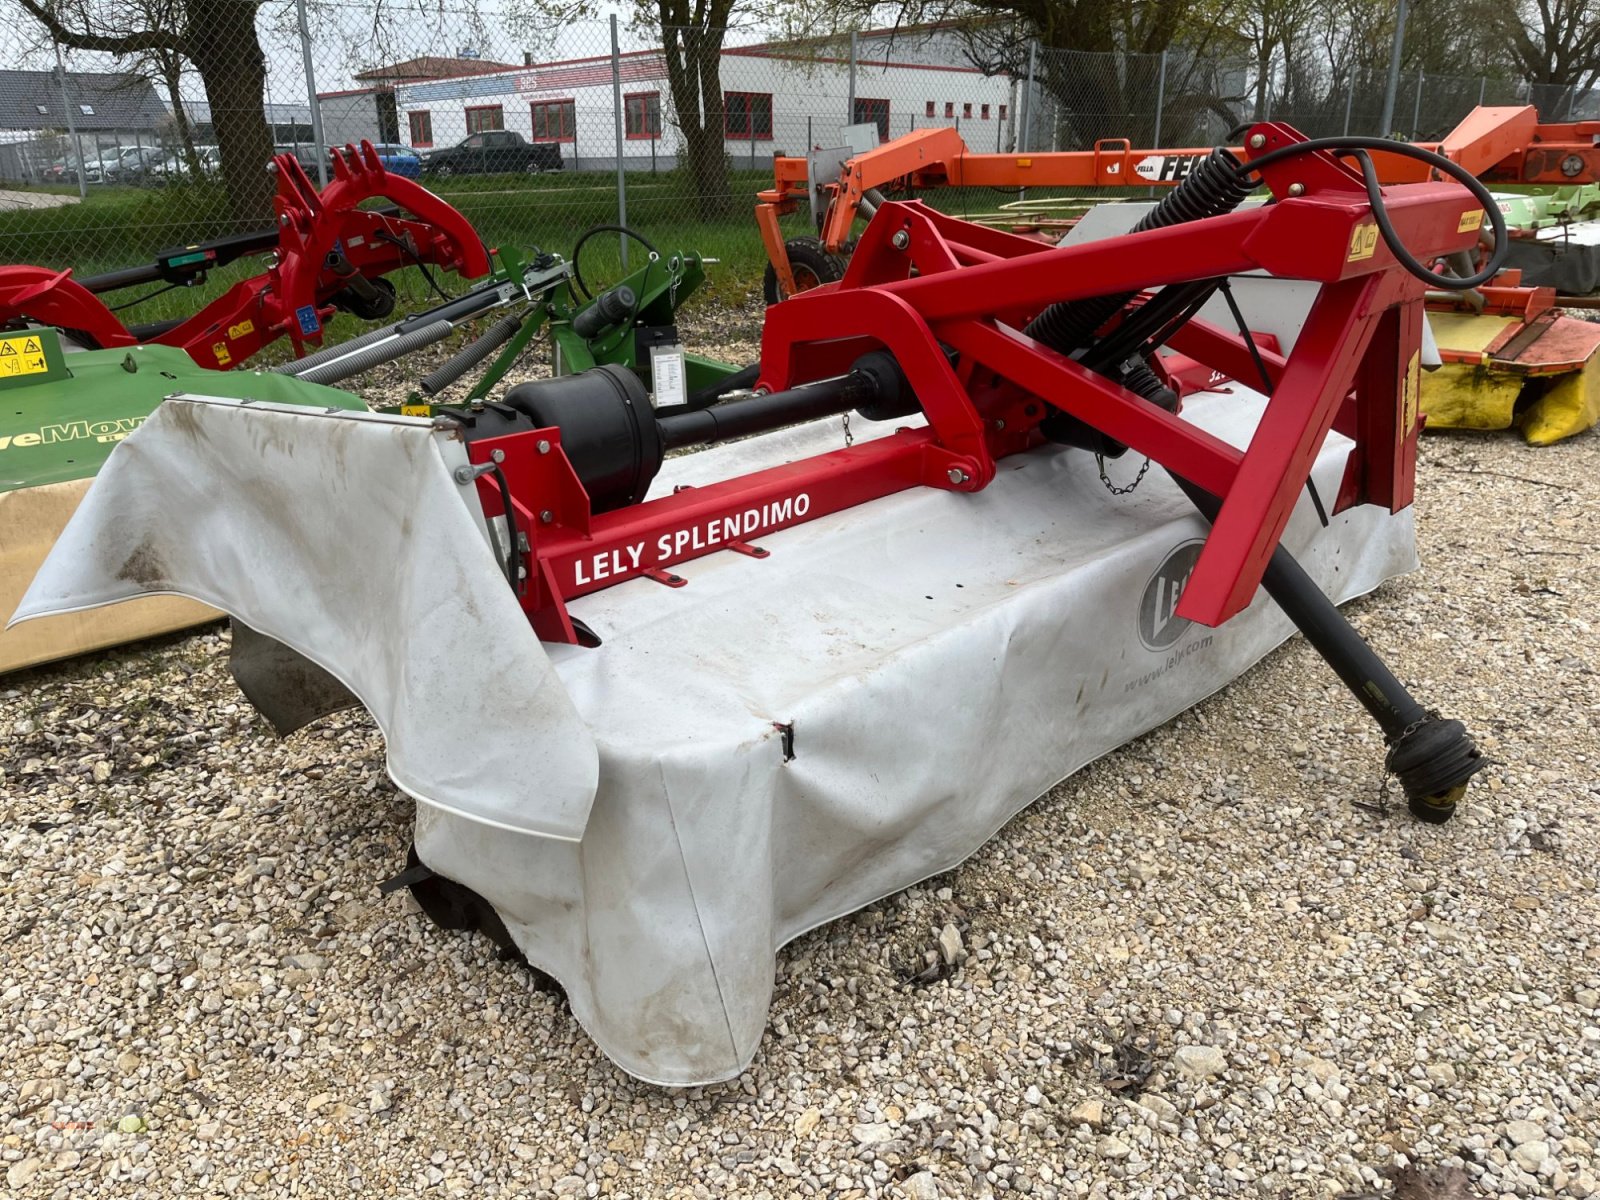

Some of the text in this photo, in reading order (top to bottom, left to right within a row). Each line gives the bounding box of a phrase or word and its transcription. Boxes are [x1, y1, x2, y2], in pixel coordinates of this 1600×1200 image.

[1136, 165, 1154, 173] FELLA
[574, 493, 810, 586] LELY SPLENDIMO
[1152, 564, 1194, 640] LE
[1124, 635, 1213, 693] www.lely.com
